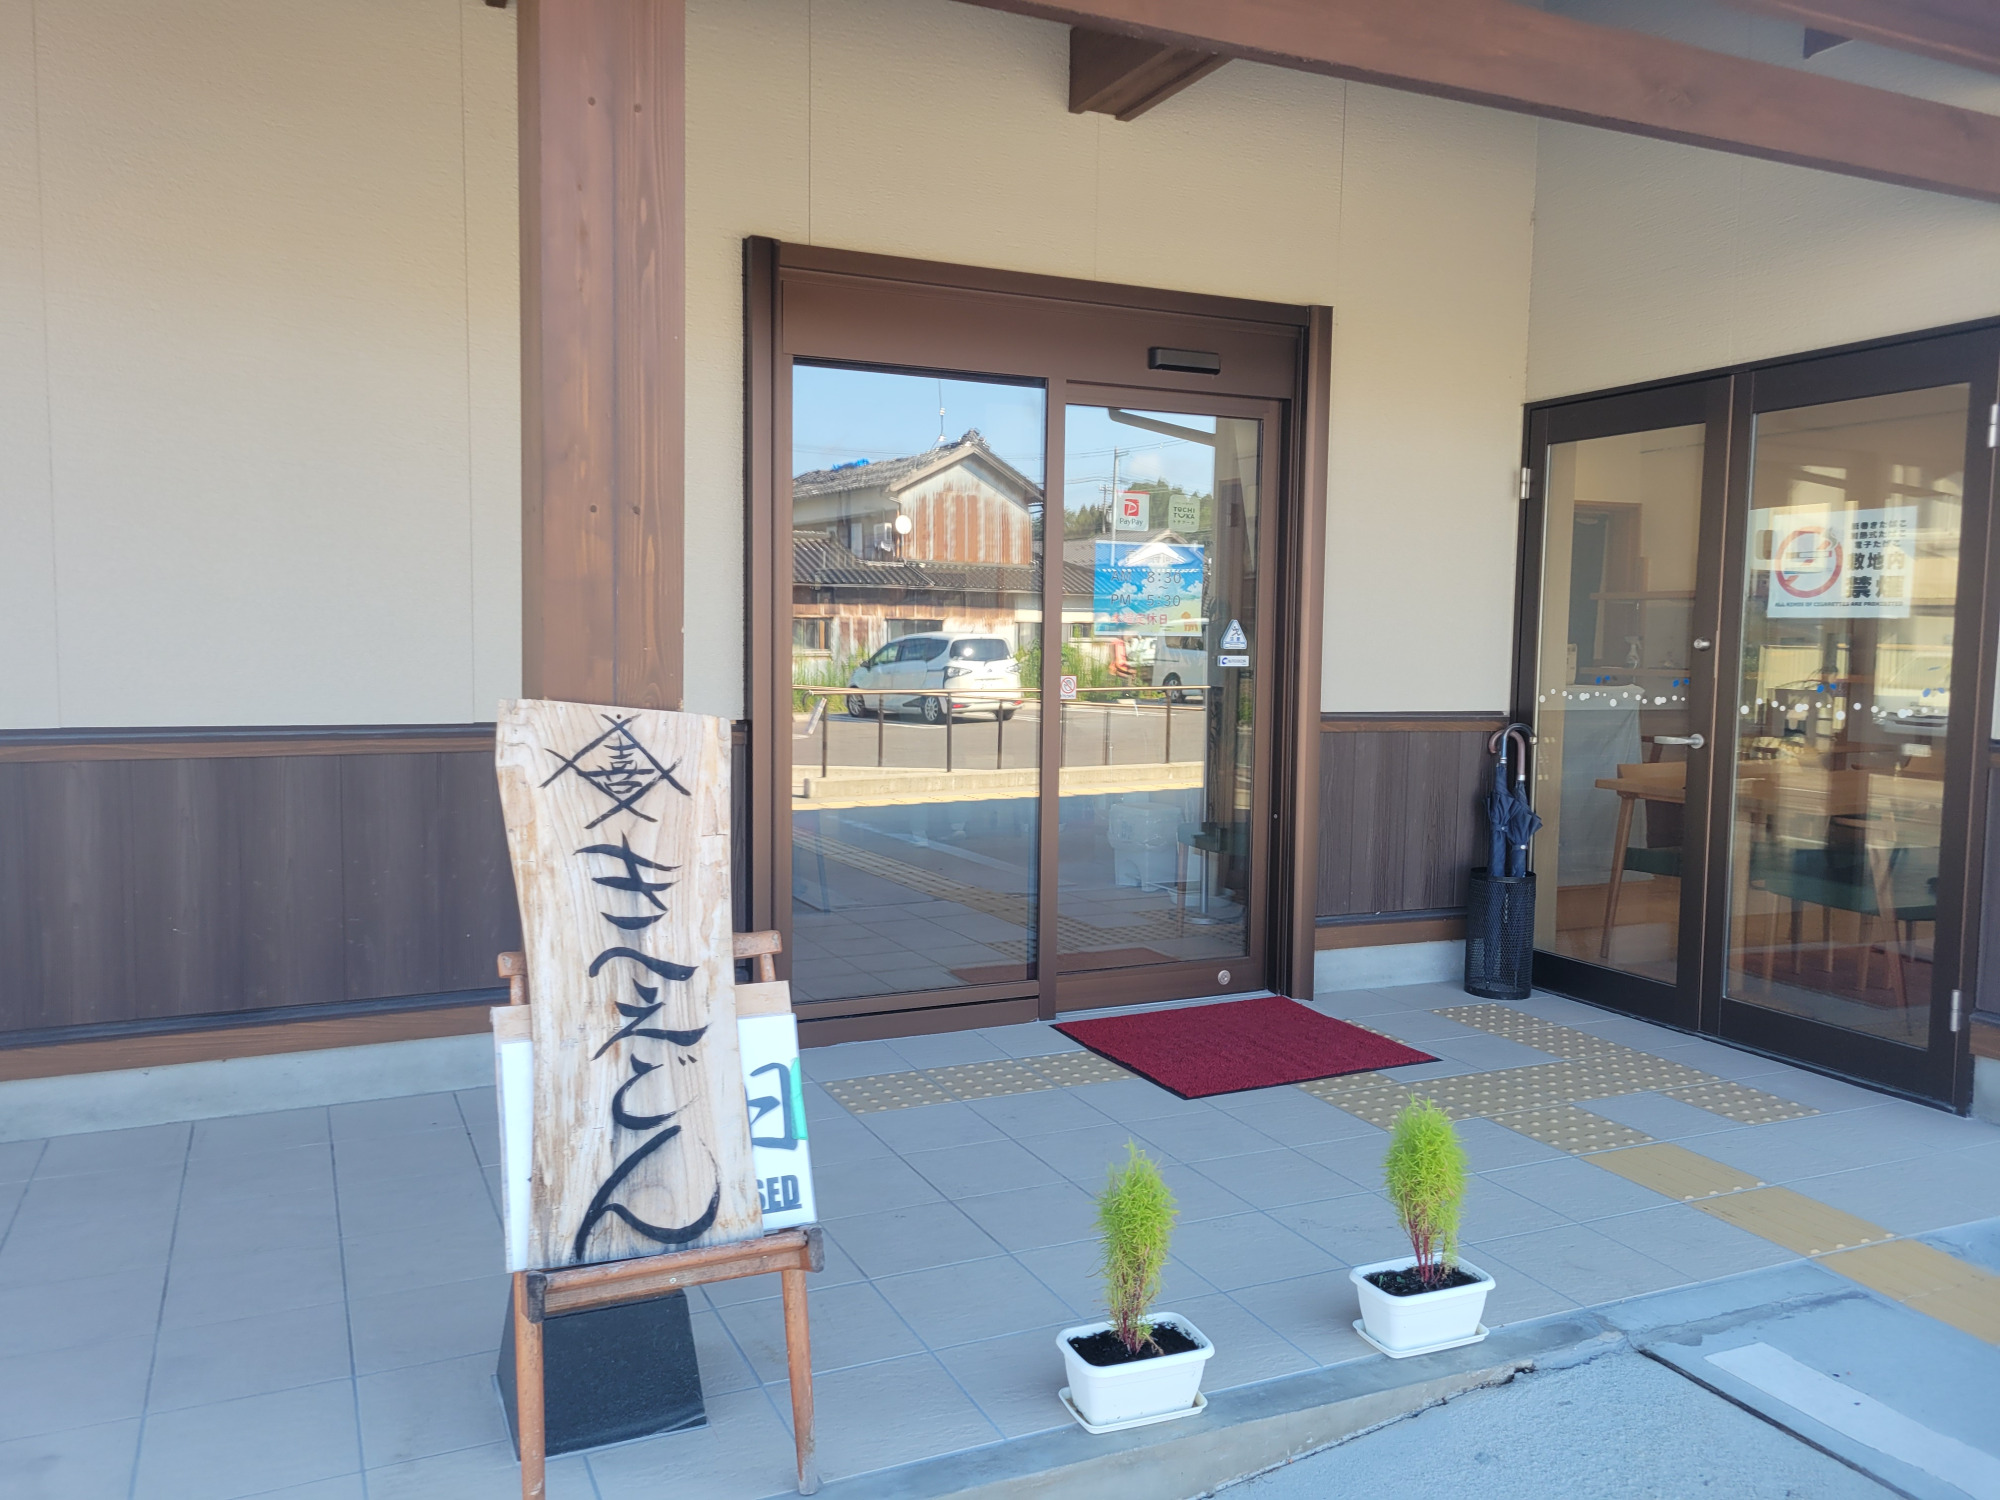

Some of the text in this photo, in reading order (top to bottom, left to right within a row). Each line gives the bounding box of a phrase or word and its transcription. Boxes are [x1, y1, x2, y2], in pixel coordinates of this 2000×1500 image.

[1119, 517, 1144, 527] PayPay
[1854, 540, 1901, 549] 電子たばこ
[1847, 552, 1905, 570] 敷地内
[1111, 571, 1182, 584] AM 8:30
[1846, 575, 1905, 598] 禁煙
[1111, 594, 1181, 607] PM 5:30
